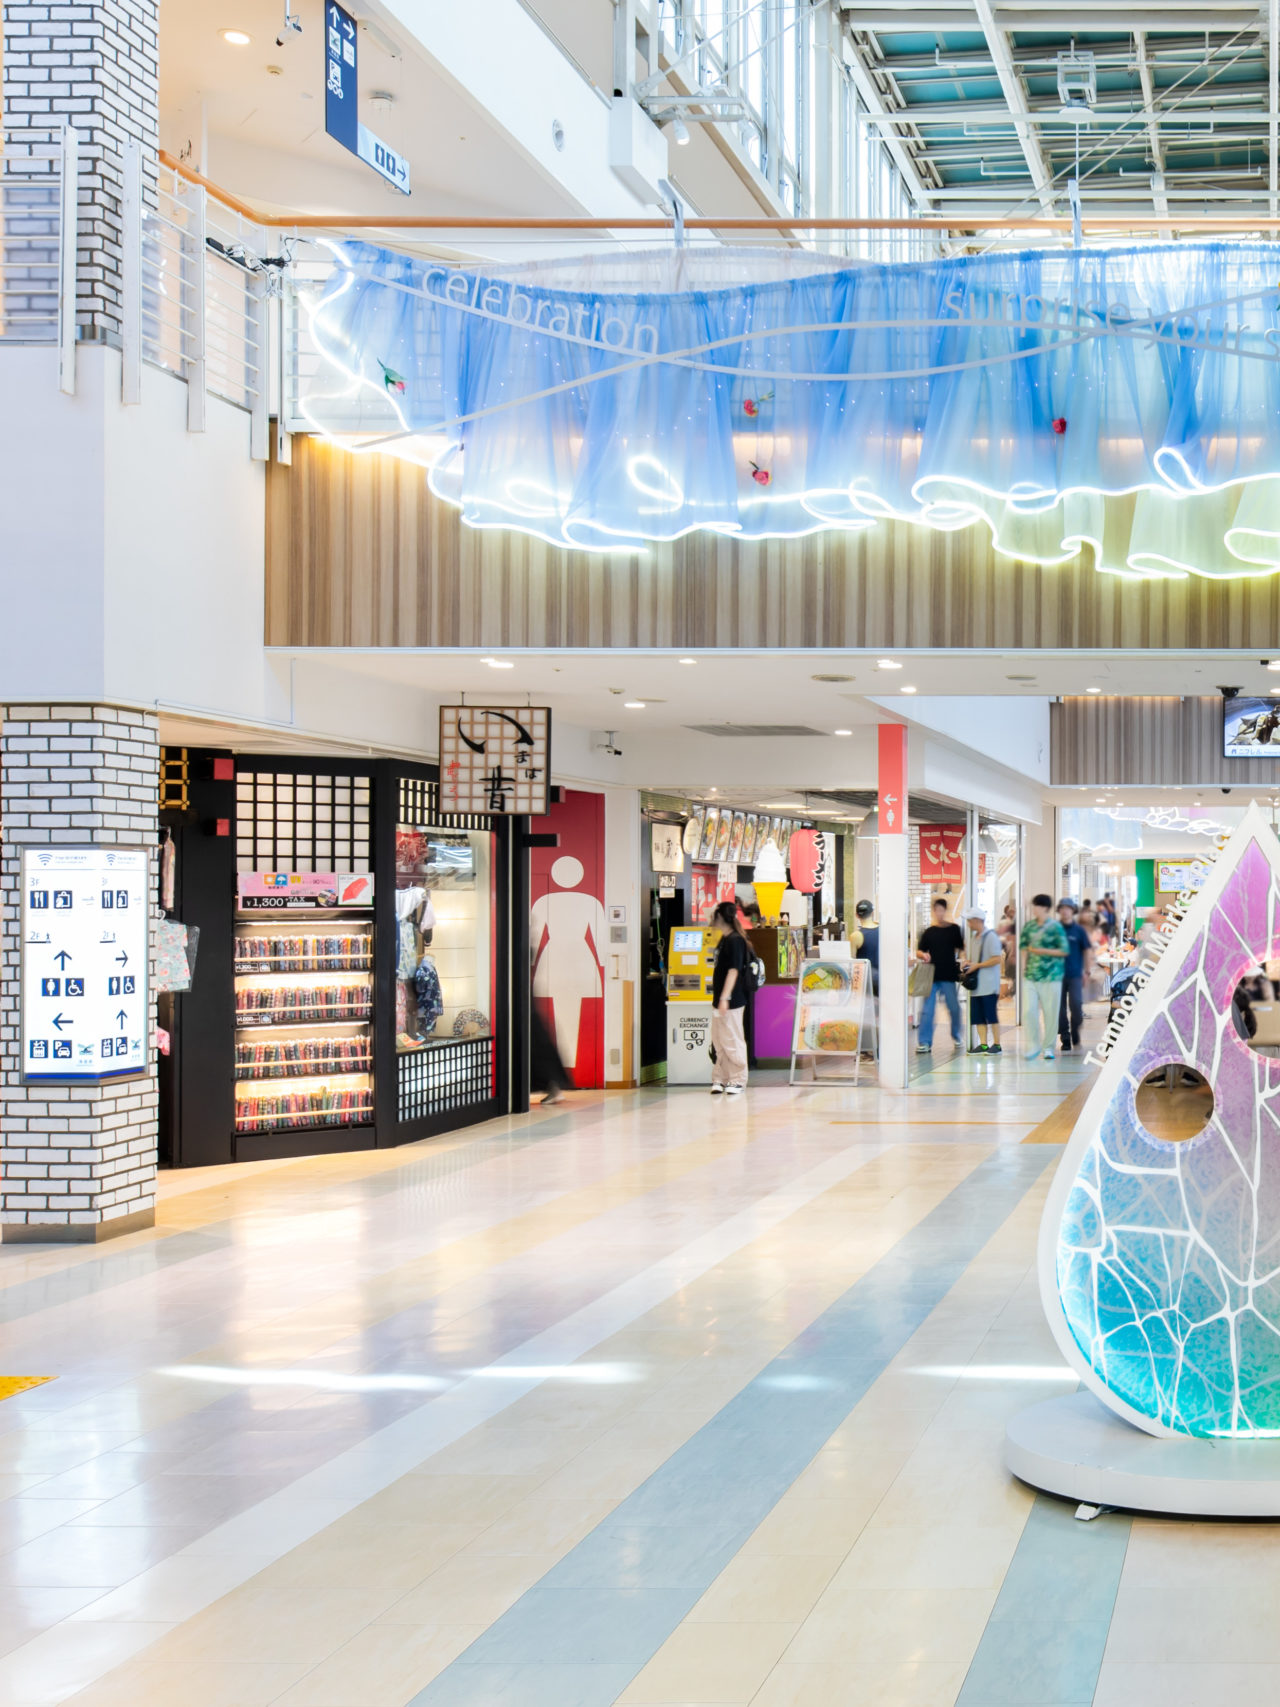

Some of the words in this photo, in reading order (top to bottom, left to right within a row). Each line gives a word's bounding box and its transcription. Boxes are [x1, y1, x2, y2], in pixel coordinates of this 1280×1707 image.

[422, 267, 660, 358] celebration
[944, 290, 1131, 337] surprise
[1143, 302, 1253, 351] your
[1084, 956, 1157, 1068] Tempozan
